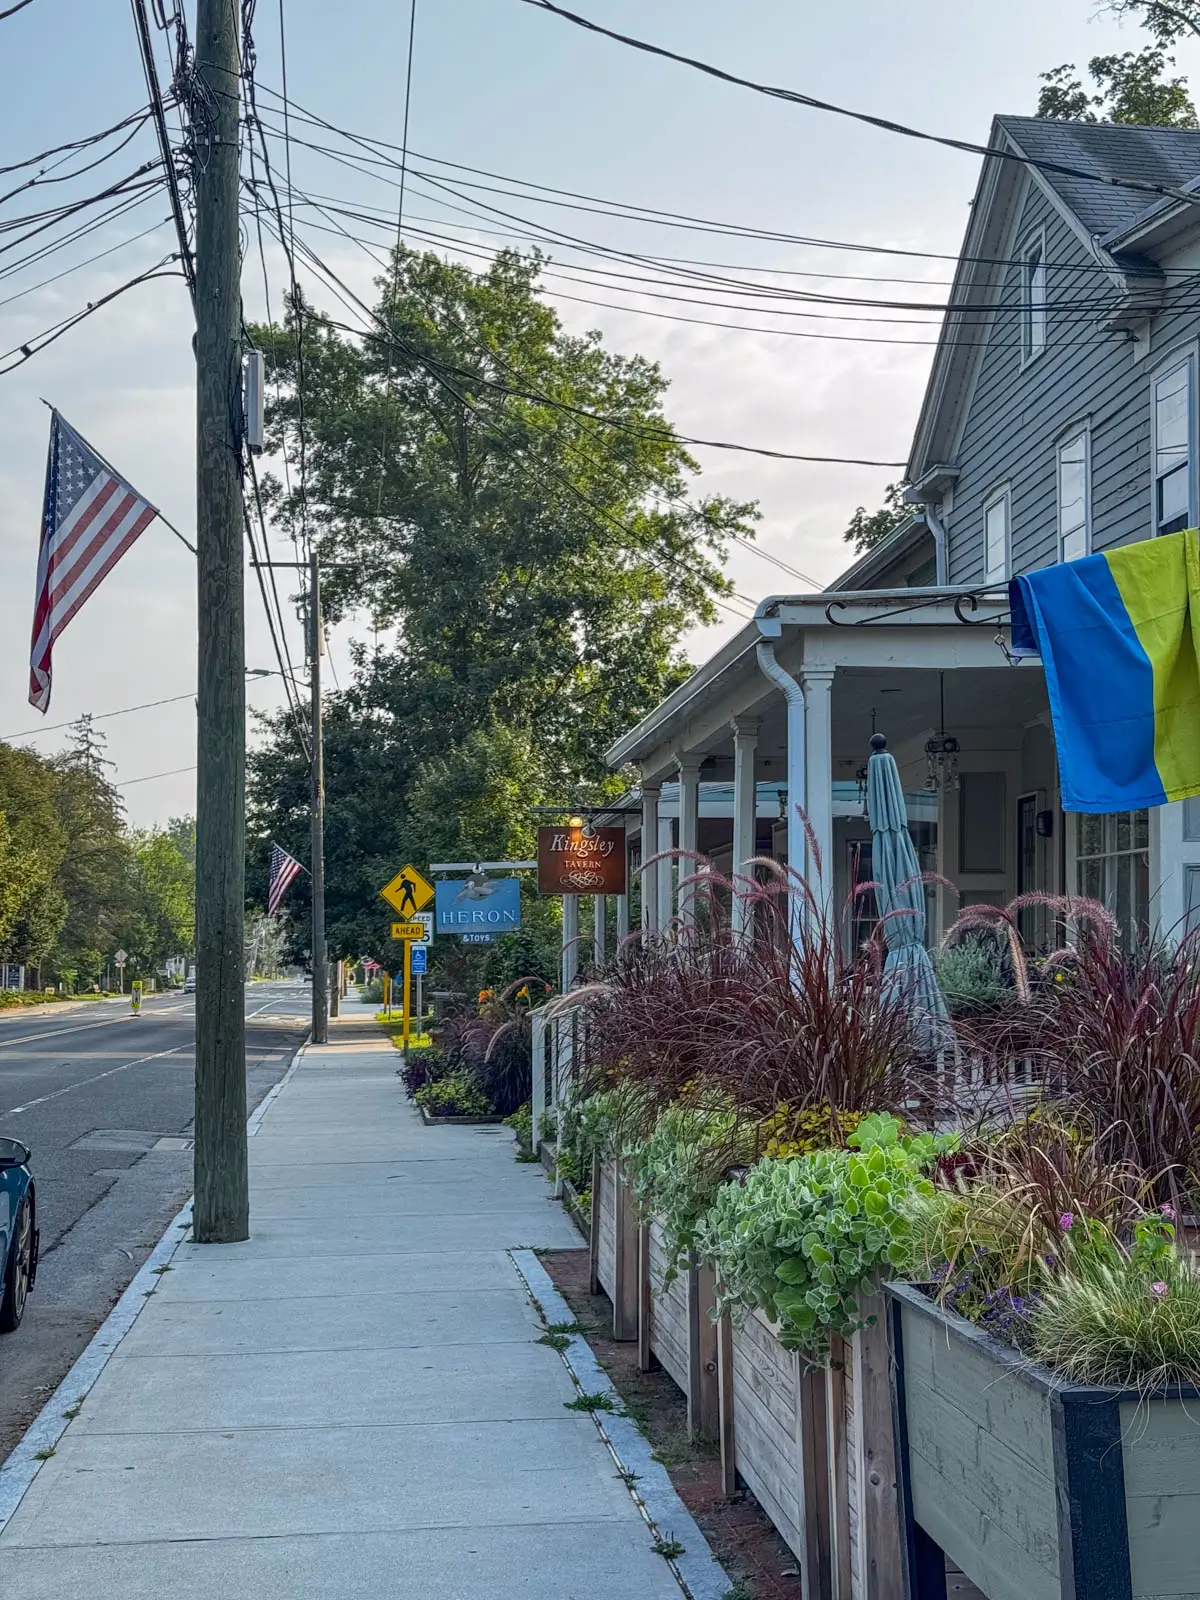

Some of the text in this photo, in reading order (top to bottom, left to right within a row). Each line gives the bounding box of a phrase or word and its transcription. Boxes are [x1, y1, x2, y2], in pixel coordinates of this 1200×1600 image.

[549, 834, 615, 857] Kingsley
[564, 860, 601, 868] TAVERN
[442, 909, 516, 924] HERON
[395, 927, 421, 935] AHEAD
